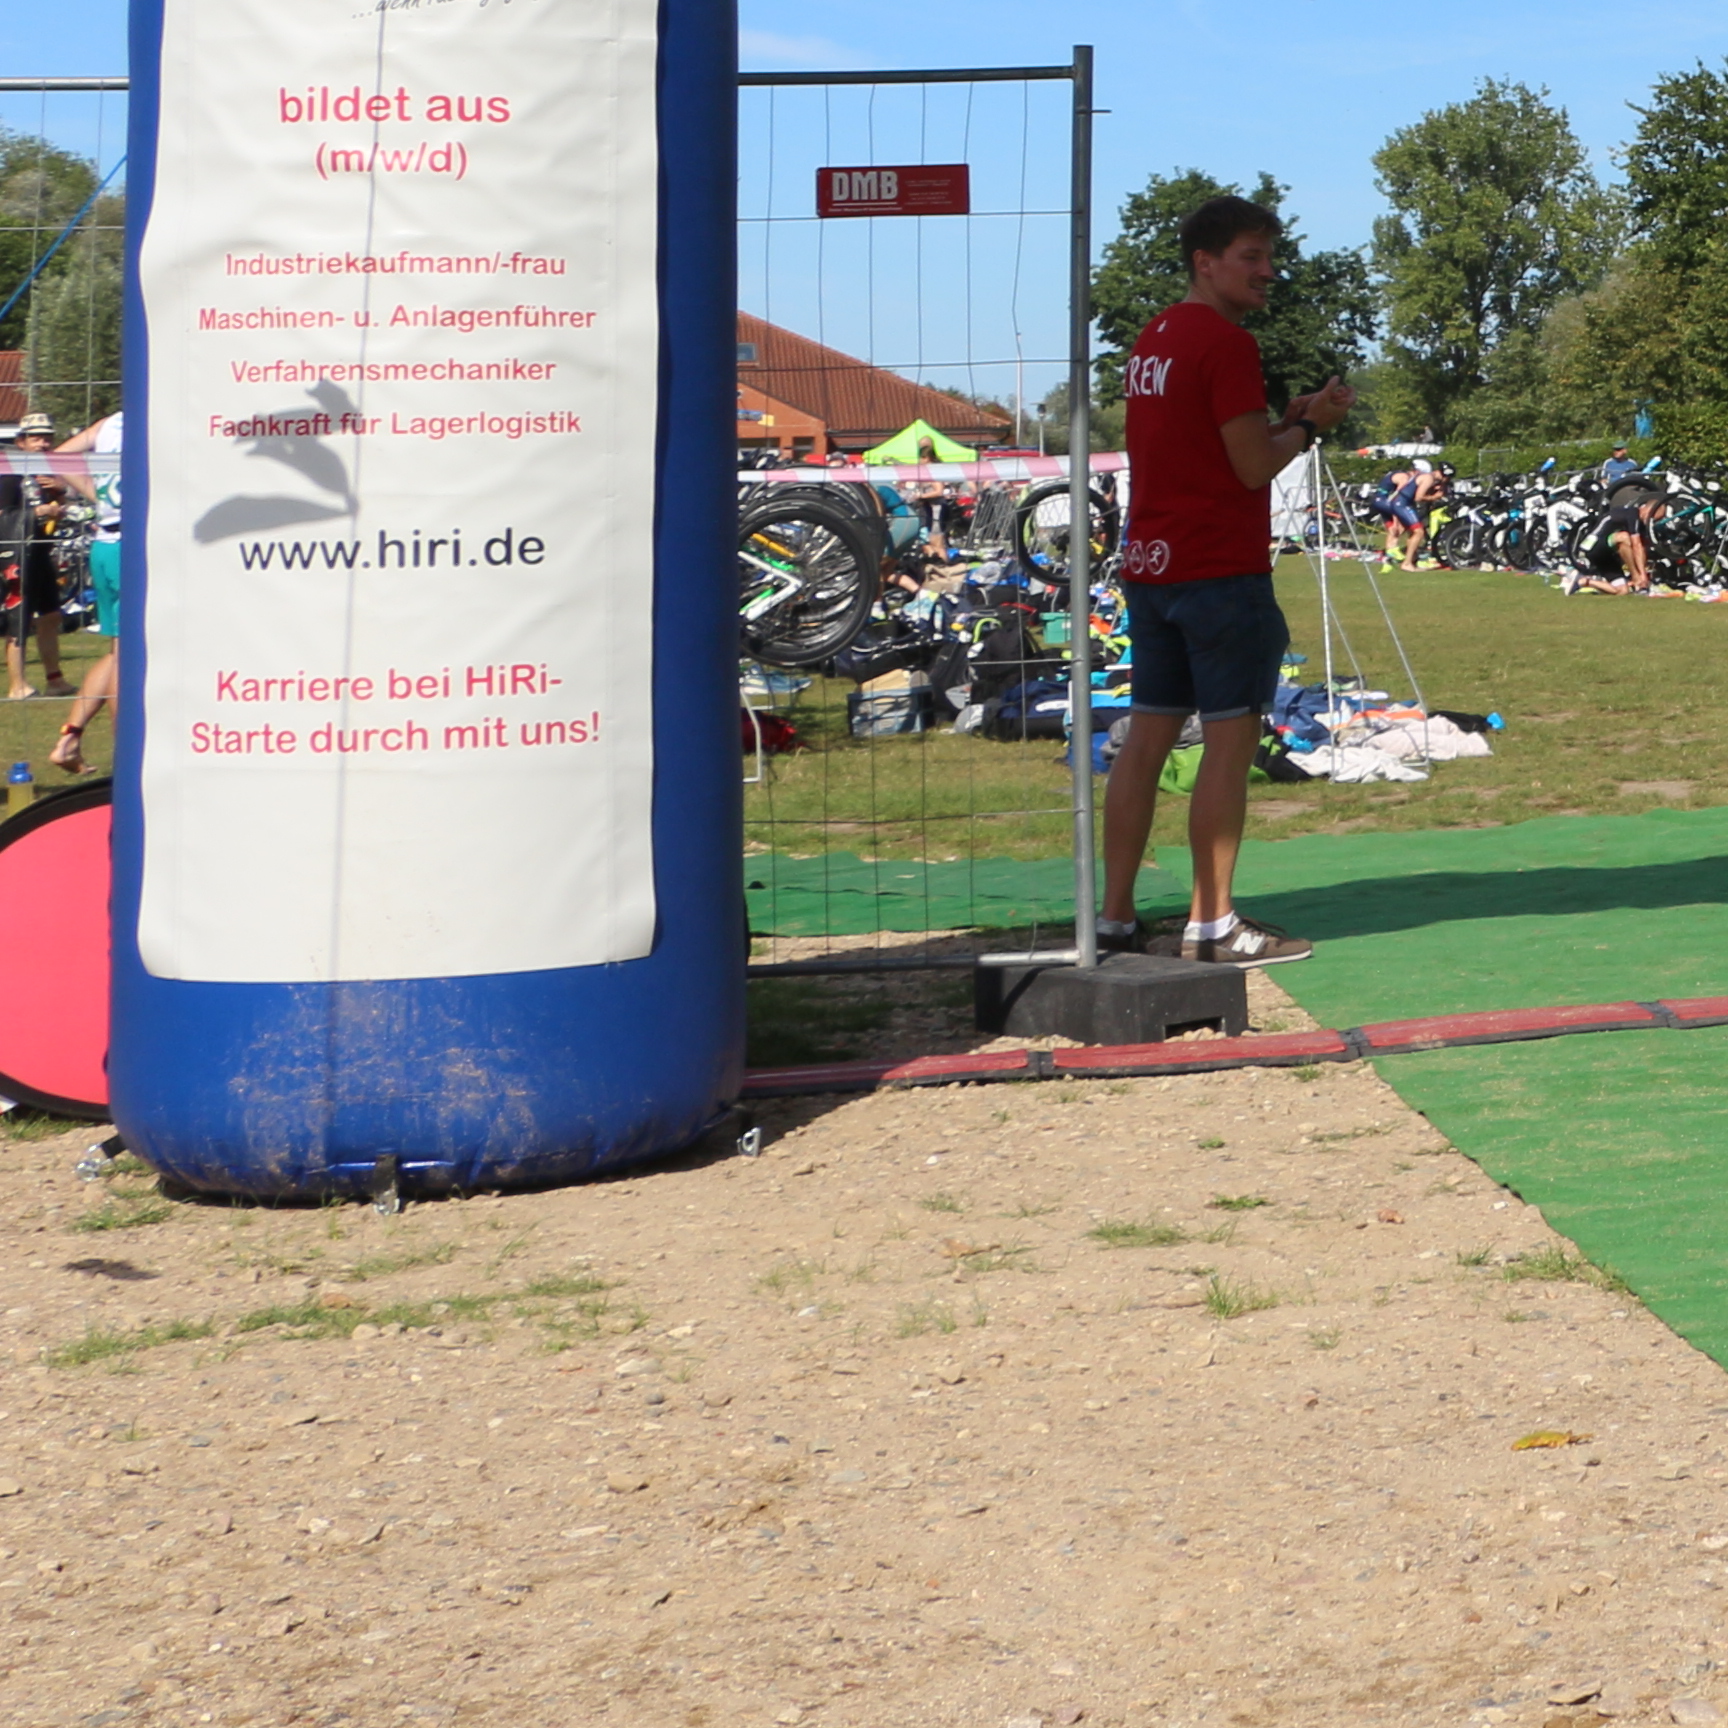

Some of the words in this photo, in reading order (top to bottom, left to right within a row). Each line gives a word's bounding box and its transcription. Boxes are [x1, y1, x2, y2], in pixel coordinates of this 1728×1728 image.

[279, 87, 413, 123] bildet
[426, 94, 511, 123] aus
[315, 142, 468, 181] (m/w/d)
[832, 170, 898, 202] DMB
[226, 252, 566, 277] Industriekaufmann/-frau
[199, 307, 345, 332] Maschinen-
[354, 310, 380, 329] u.
[390, 303, 597, 334] Anlagenführer
[231, 360, 557, 384] Verfahrensmechaniker
[210, 412, 332, 437] Fachkraft
[339, 412, 381, 437] für
[391, 411, 582, 440] Lagerlogistik
[239, 527, 546, 571] www.hiri.de
[215, 670, 374, 702] Karriere
[387, 668, 451, 700] bei
[465, 663, 563, 697] HiRi-
[190, 722, 297, 754] Starte
[309, 719, 428, 752] durch
[443, 716, 509, 748] mit
[520, 711, 601, 747] uns!
